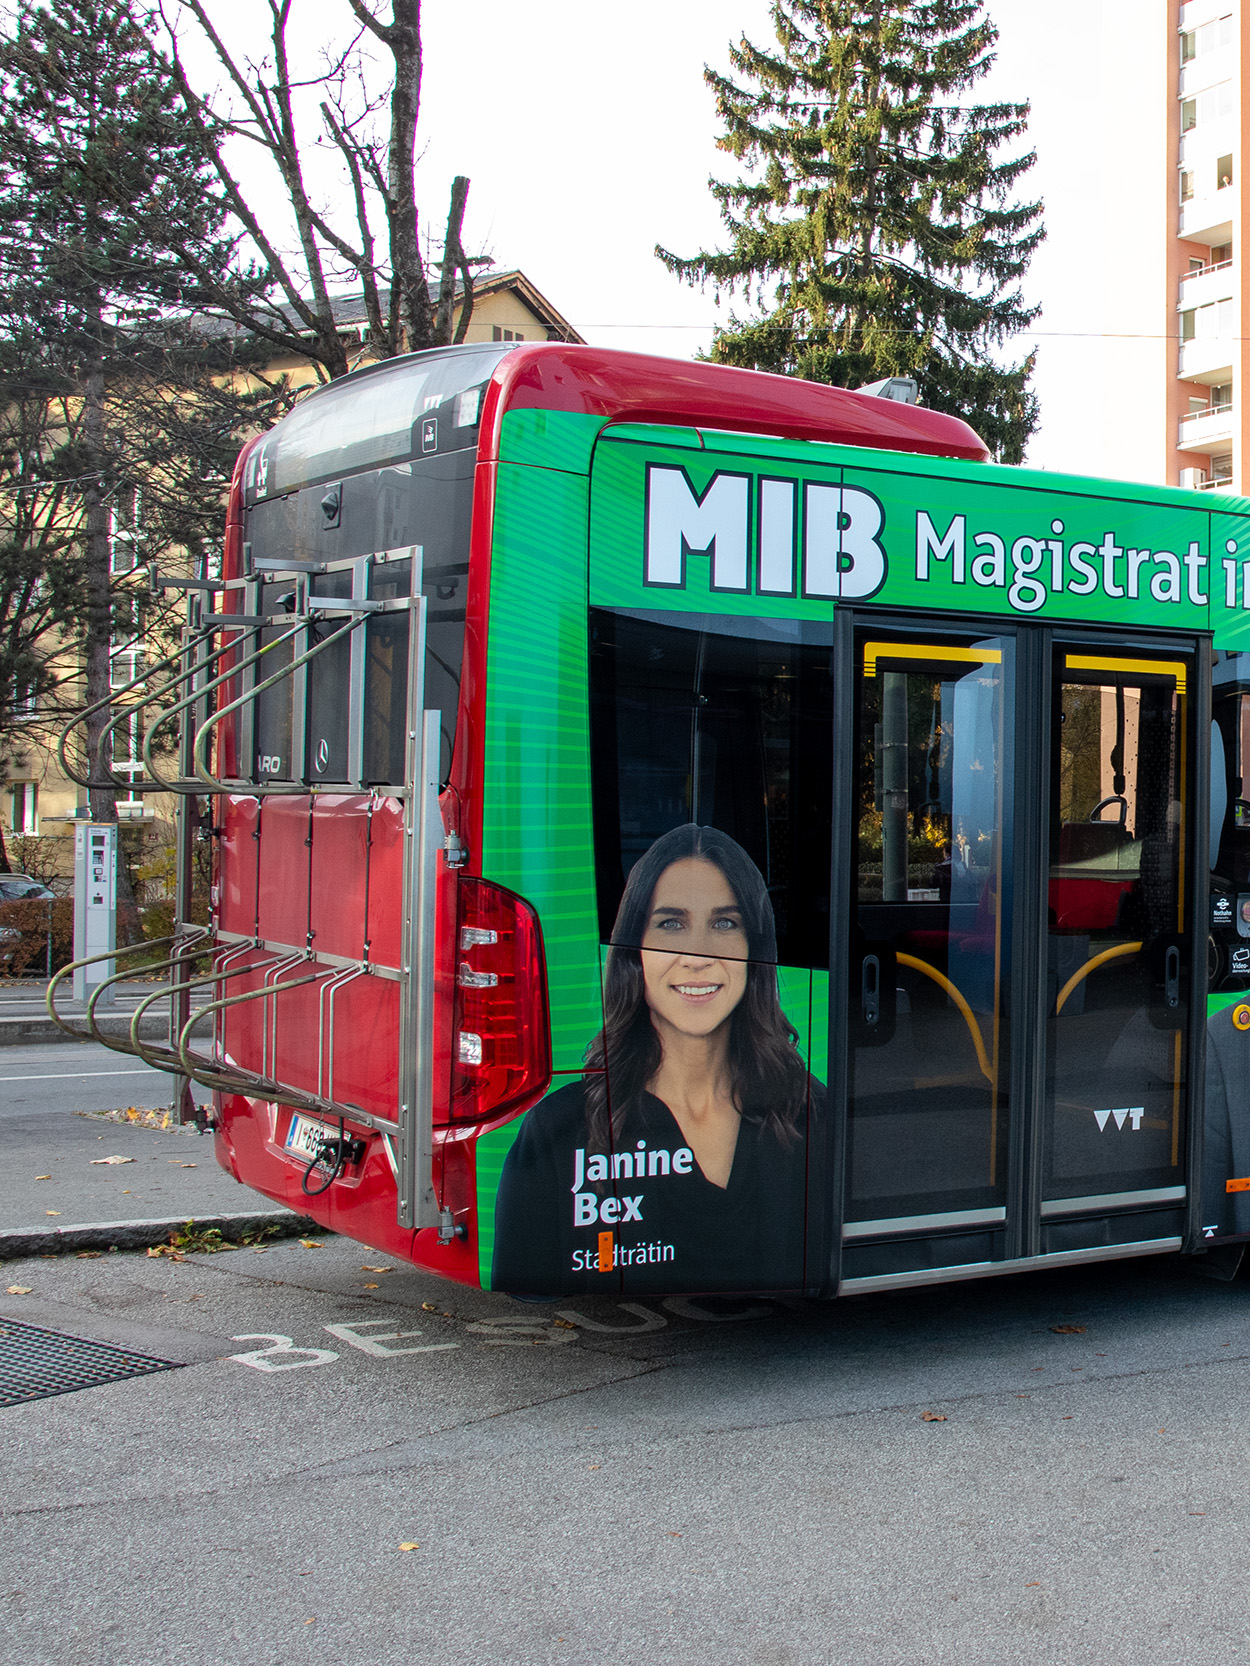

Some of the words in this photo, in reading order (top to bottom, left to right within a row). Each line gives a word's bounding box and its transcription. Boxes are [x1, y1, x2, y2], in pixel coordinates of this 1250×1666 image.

[644, 462, 888, 602] MIB
[915, 509, 1209, 612] Magistrat
[570, 1139, 694, 1194] Janine
[573, 1192, 644, 1227] Bex
